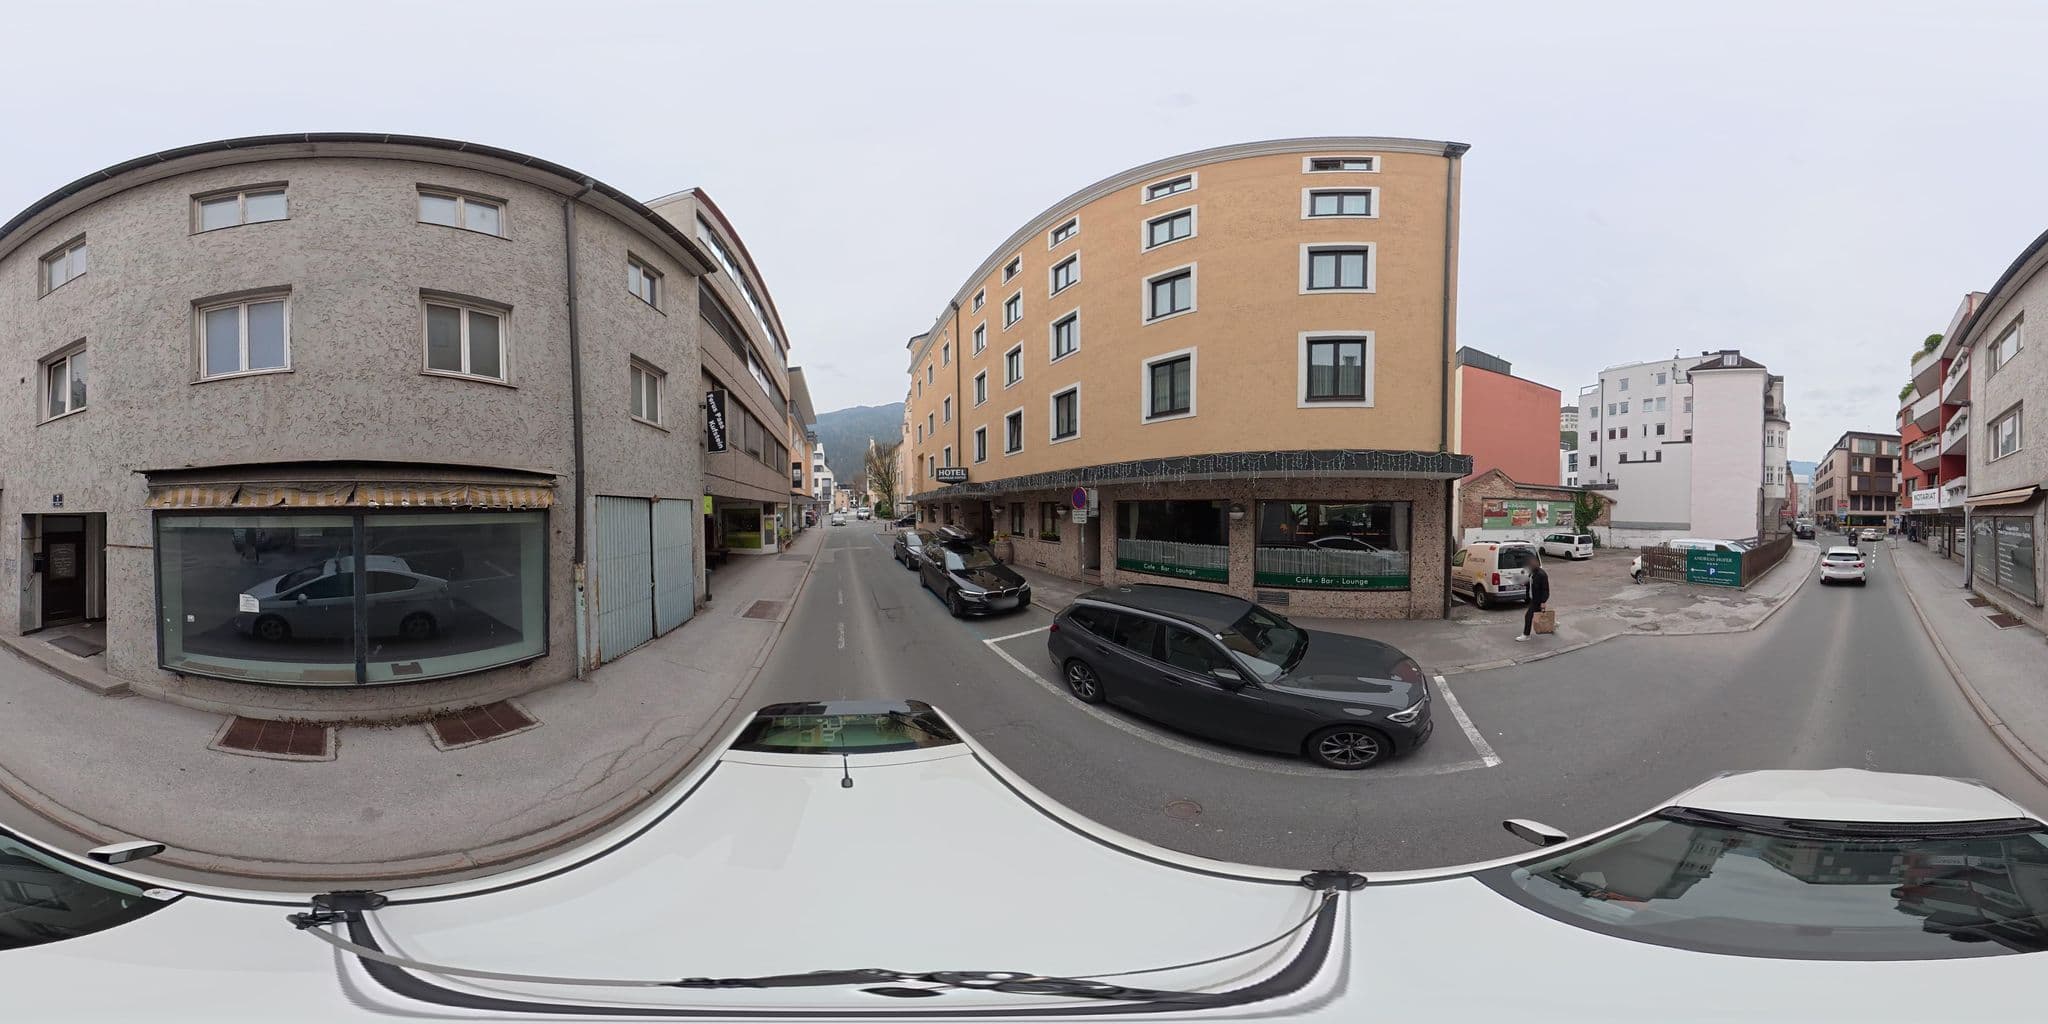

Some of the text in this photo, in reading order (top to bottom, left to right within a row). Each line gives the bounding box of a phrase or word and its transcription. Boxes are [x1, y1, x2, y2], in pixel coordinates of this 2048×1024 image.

[715, 412, 725, 430] Pass
[709, 420, 724, 449] Kufstein
[1175, 567, 1196, 576] Lounge
[1295, 576, 1369, 586] Cafe Bar Lounge
